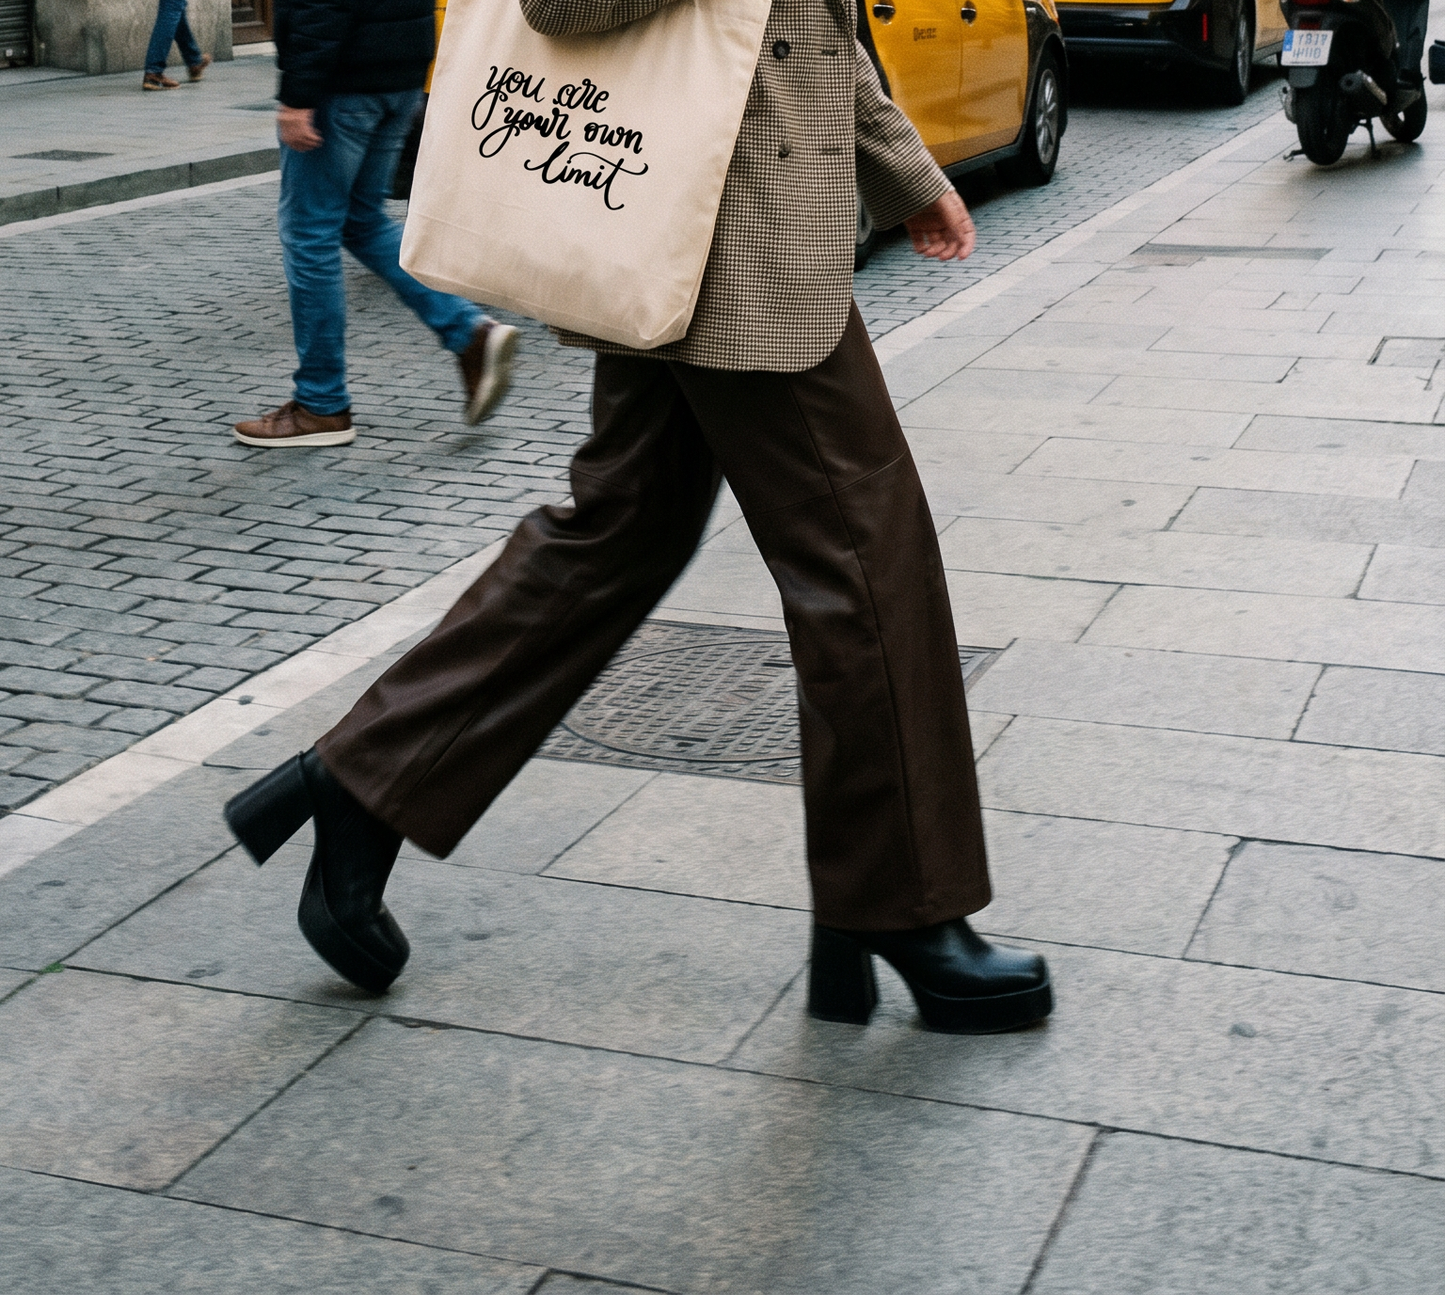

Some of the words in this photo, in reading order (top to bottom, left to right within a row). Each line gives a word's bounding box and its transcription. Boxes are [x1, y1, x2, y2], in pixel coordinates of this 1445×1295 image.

[471, 65, 546, 131] you
[553, 78, 610, 114] are
[479, 106, 572, 158] your
[583, 122, 643, 154] own
[524, 141, 649, 211] limit
